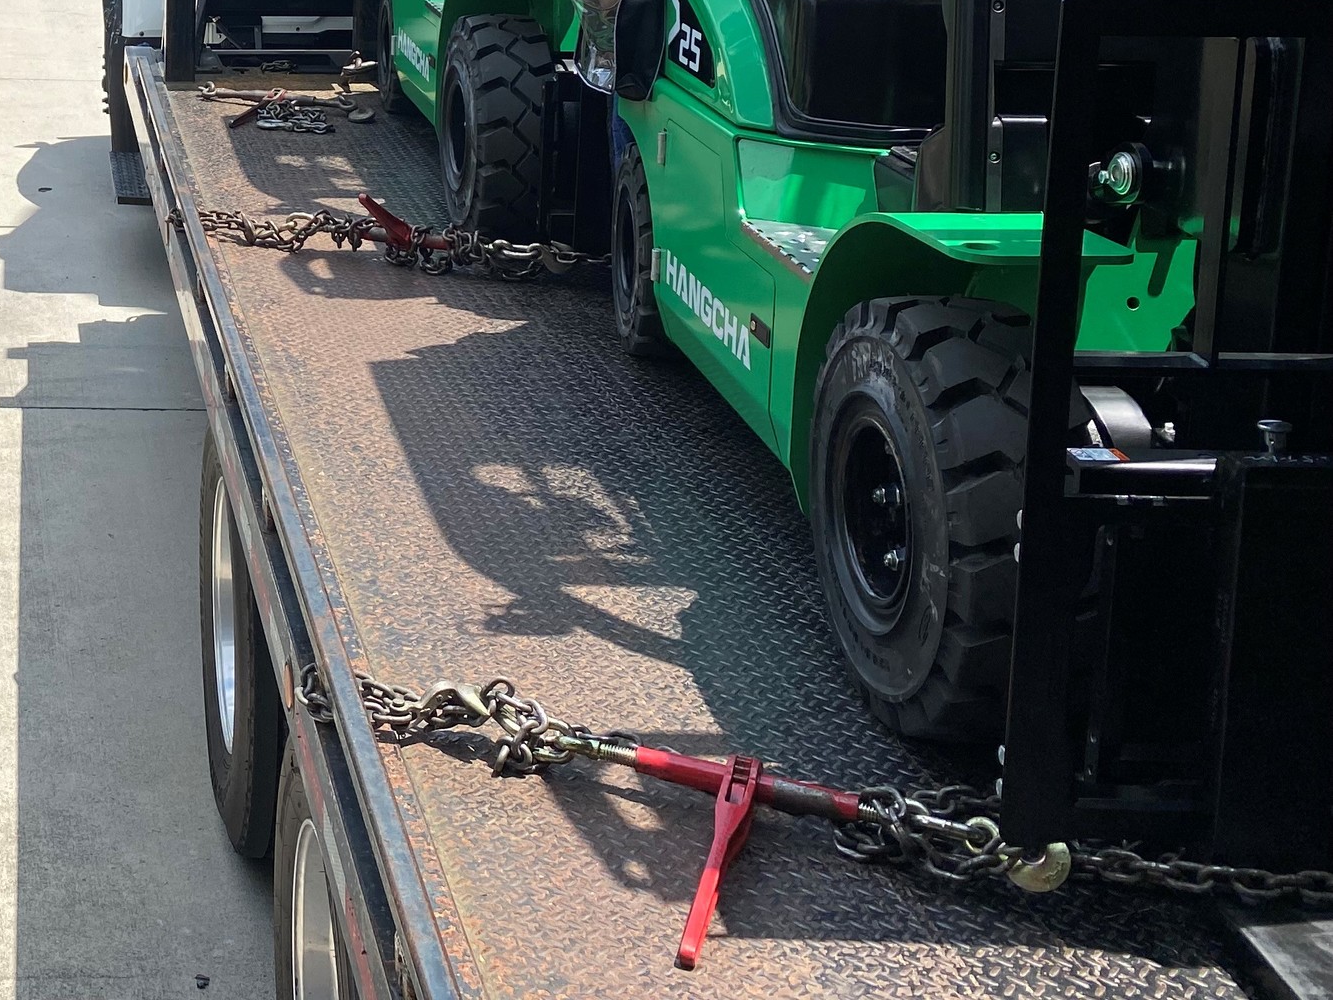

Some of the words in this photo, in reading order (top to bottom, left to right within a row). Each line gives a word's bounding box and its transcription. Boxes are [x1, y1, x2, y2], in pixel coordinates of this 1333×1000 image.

[397, 26, 430, 82] HANGCHA
[679, 22, 702, 73] 25
[666, 249, 751, 371] HANGCHA
